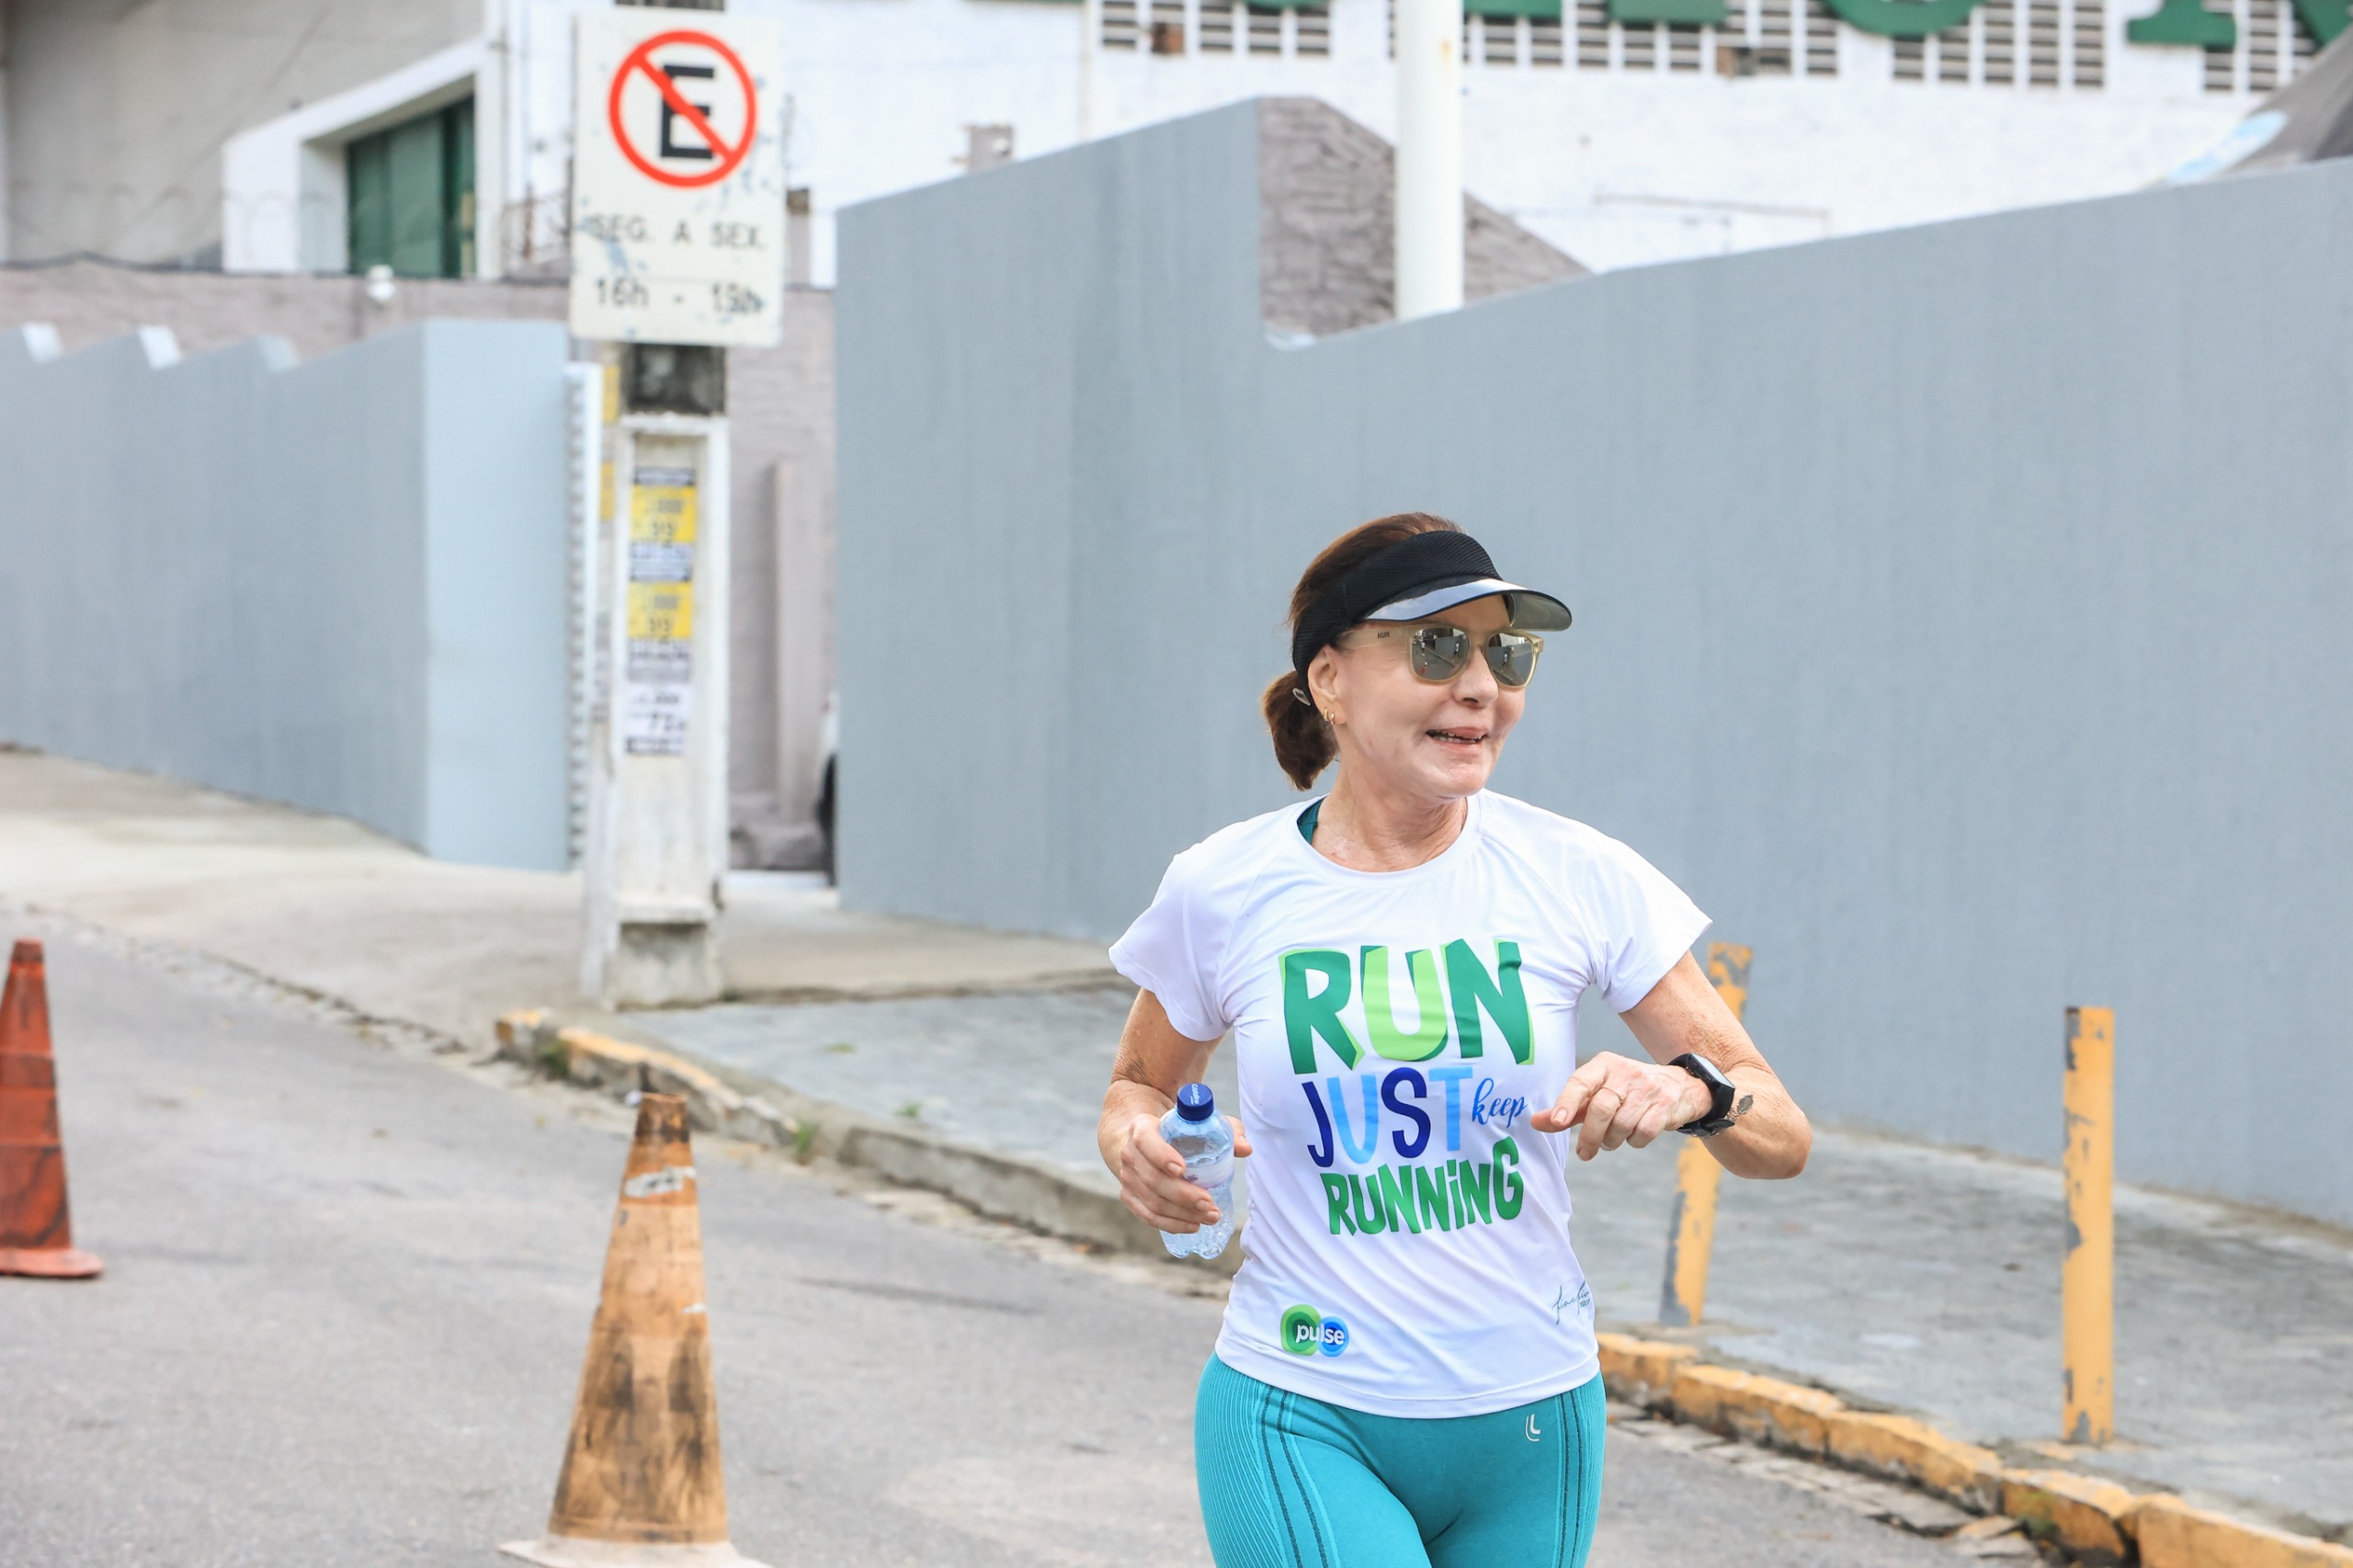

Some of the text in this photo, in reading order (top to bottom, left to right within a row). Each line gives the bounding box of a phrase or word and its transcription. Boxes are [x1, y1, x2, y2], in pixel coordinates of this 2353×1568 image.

[660, 62, 715, 159] E
[673, 220, 692, 244] A
[1278, 937, 1535, 1074] RUN
[1302, 1066, 1529, 1167] JUST keep
[1295, 1323, 1346, 1346] pulse
